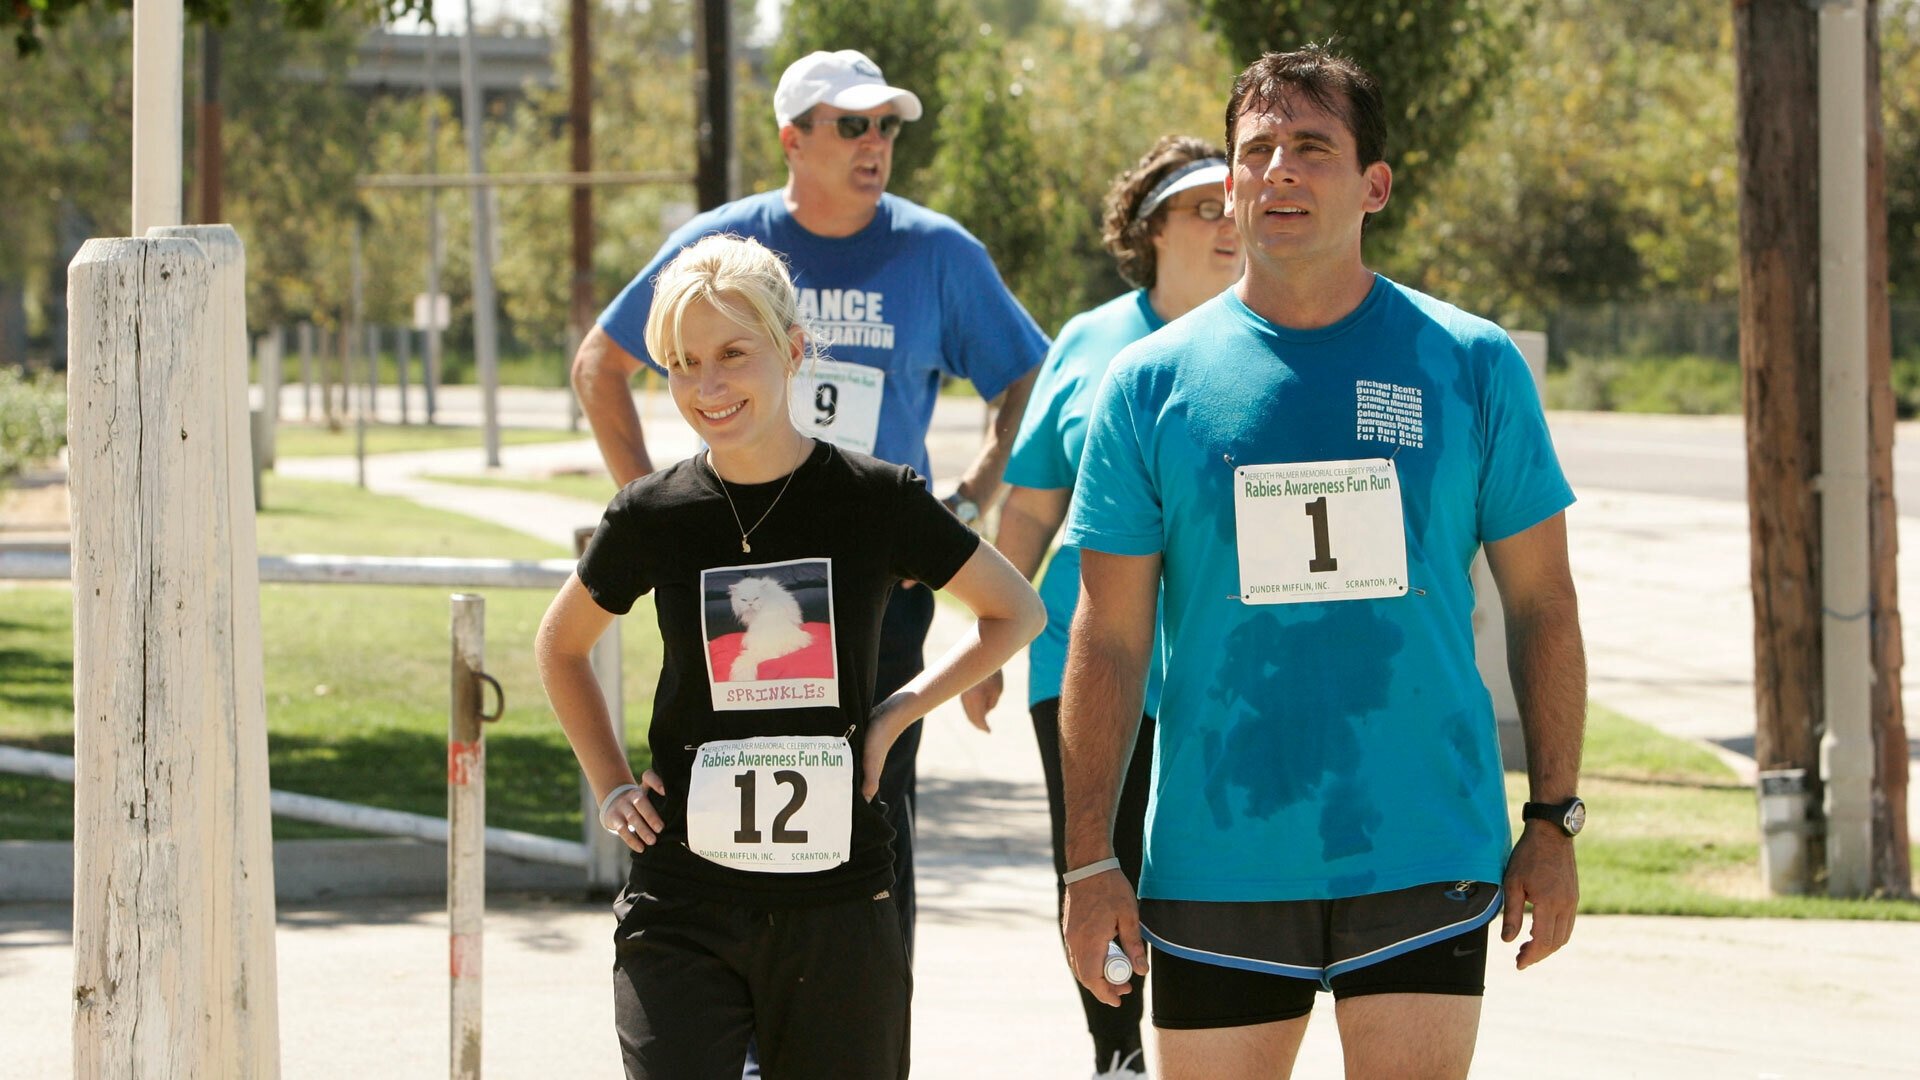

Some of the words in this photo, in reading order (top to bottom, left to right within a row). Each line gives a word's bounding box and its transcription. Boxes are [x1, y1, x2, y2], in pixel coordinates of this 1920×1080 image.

[1356, 380, 1391, 391] Michael
[1392, 384, 1422, 396] Scott's
[1356, 387, 1391, 398] Dunder
[1392, 392, 1422, 403] Mifflin
[815, 383, 838, 426] 9
[1357, 395, 1390, 405] Scranton
[1390, 400, 1422, 411] Meredith
[1357, 402, 1385, 411] Palmer
[1386, 406, 1422, 418] Memorial
[1357, 410, 1394, 421] Celebrity
[1395, 415, 1422, 426] Rabies
[1357, 418, 1396, 429] Awareness
[1397, 422, 1423, 433] Pro-Am
[1357, 425, 1375, 433] Fun
[1377, 427, 1396, 436] Run
[1399, 430, 1423, 441] Race
[1377, 434, 1396, 444] The
[1399, 438, 1423, 448] Cure
[1245, 471, 1274, 481] MEREDITH
[1276, 470, 1299, 479] PALMER
[1300, 469, 1332, 478] MEMORIAL
[1334, 466, 1365, 476] CELEBRITY
[1366, 465, 1388, 474] PRO-AM
[1245, 480, 1282, 498] Rabies
[1284, 479, 1345, 496] Awareness
[1347, 476, 1368, 492] Fun
[1370, 474, 1391, 490] Run
[1305, 497, 1338, 573] 1
[1250, 584, 1281, 593] DUNDER
[1282, 583, 1314, 592] MIFFLIN,
[1315, 581, 1330, 590] INC.
[1345, 579, 1387, 589] SCRANTON,
[1389, 577, 1398, 585] PA
[726, 683, 825, 702] SPRINKLES
[731, 742, 753, 750] PALMER
[754, 742, 785, 750] MEMORIAL
[787, 742, 817, 750] CELEBRITY
[817, 742, 842, 750] PRO-AM
[702, 751, 736, 768] Rabies
[738, 750, 796, 766] Awareness
[799, 750, 819, 766] Fun
[821, 750, 843, 766] Run
[734, 770, 808, 843] 12
[729, 852, 760, 861] MIFFLIN,
[761, 853, 775, 861] INC.
[791, 852, 831, 861] SCRANTON,
[832, 851, 841, 859] PA
